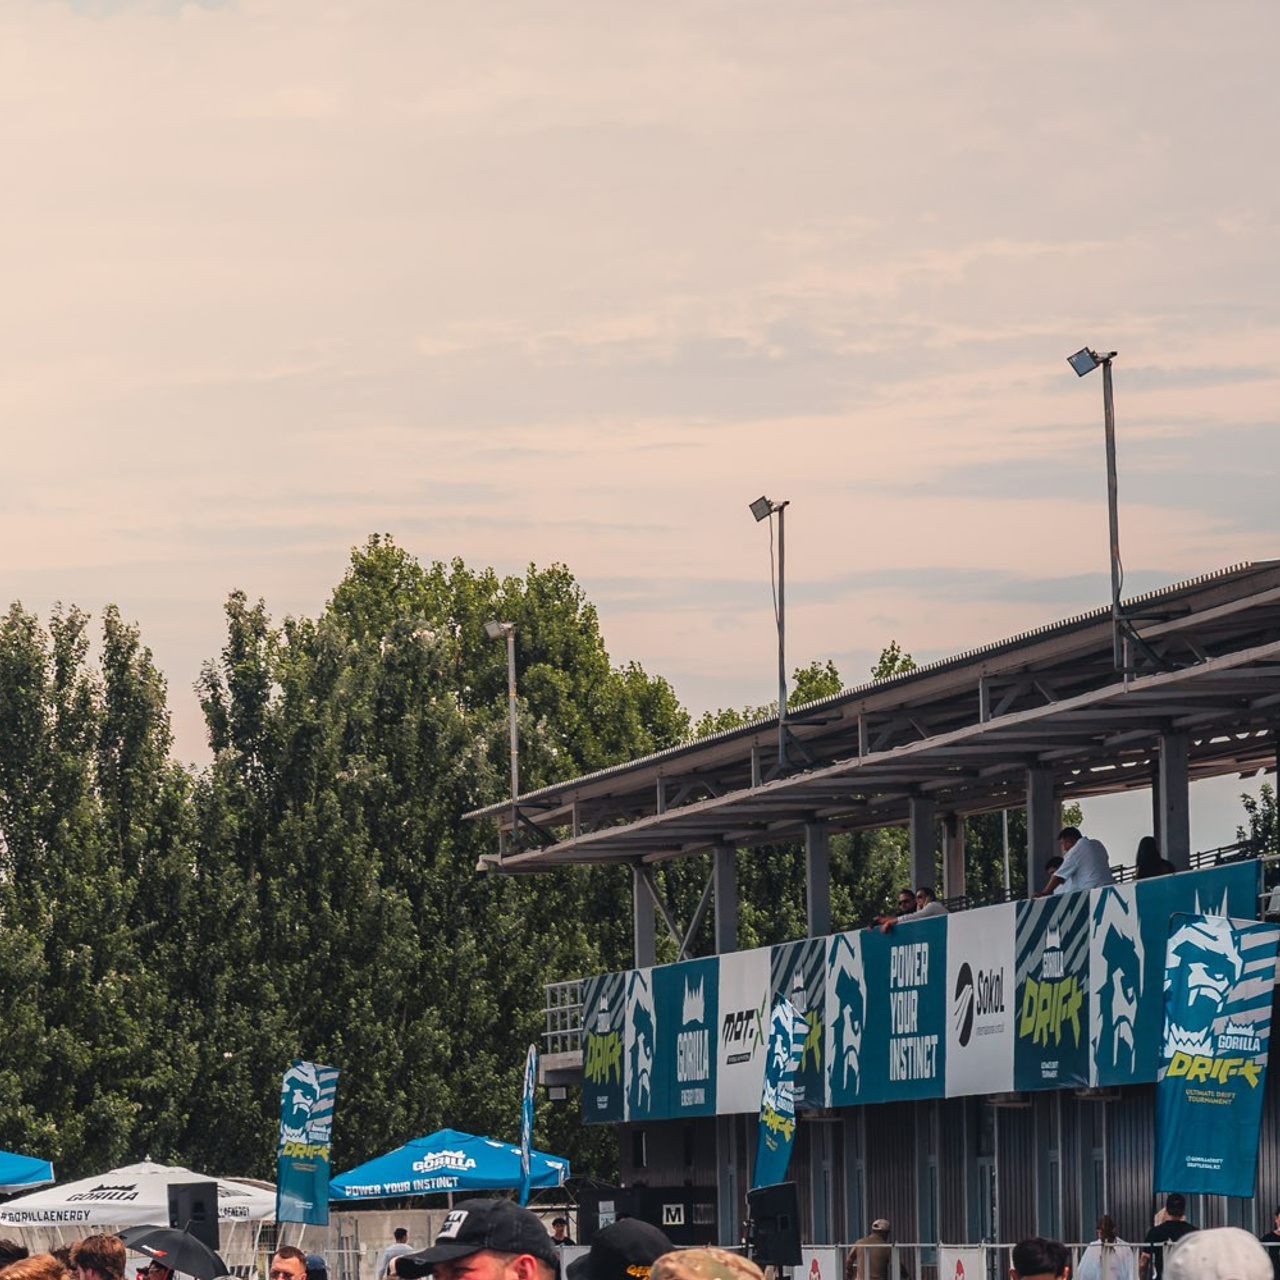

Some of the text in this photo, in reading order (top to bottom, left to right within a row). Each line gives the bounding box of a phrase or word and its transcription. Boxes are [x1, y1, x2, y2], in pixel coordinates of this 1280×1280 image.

[890, 943, 929, 988] POWER
[890, 990, 918, 1034] YOUR
[1020, 974, 1083, 1049] DRIFT
[585, 1030, 622, 1086] DRIFT
[677, 1029, 710, 1082] GORILLA
[890, 1035, 938, 1080] INSTINCT
[1218, 1036, 1261, 1051] GORILLA
[1166, 1051, 1263, 1089] DRIFT
[282, 1139, 331, 1162] DRIFT
[412, 1156, 477, 1171] GORILLA
[66, 1191, 140, 1202] GORILLA
[345, 1177, 459, 1196] POWER YOUR INSTINCT
[0, 1210, 91, 1222] #GORILLAENERGY
[665, 1208, 681, 1222] M
